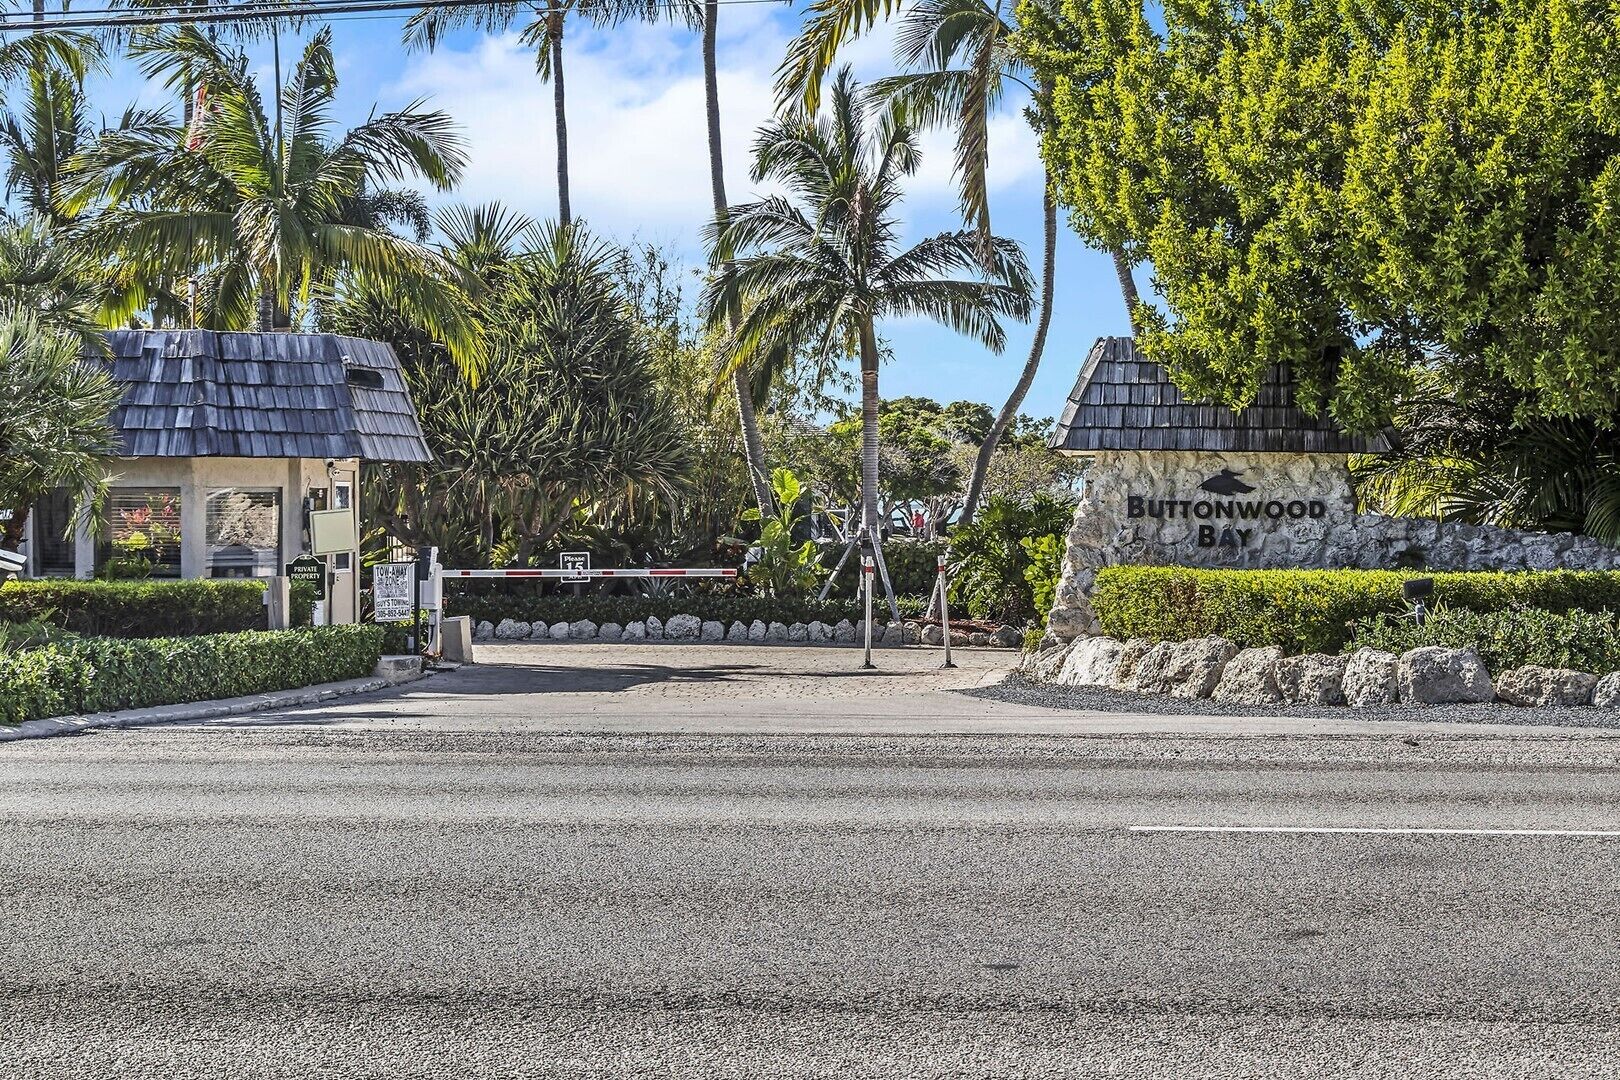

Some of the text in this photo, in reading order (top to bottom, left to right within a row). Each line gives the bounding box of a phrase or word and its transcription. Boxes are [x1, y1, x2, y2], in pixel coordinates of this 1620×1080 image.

[1127, 495, 1326, 520] BUTTONWOOD
[1198, 524, 1252, 548] BAY
[375, 565, 407, 577] TOW-AWAY
[566, 562, 584, 572] 15
[384, 576, 399, 586] ZONE
[391, 598, 409, 607] TOWING
